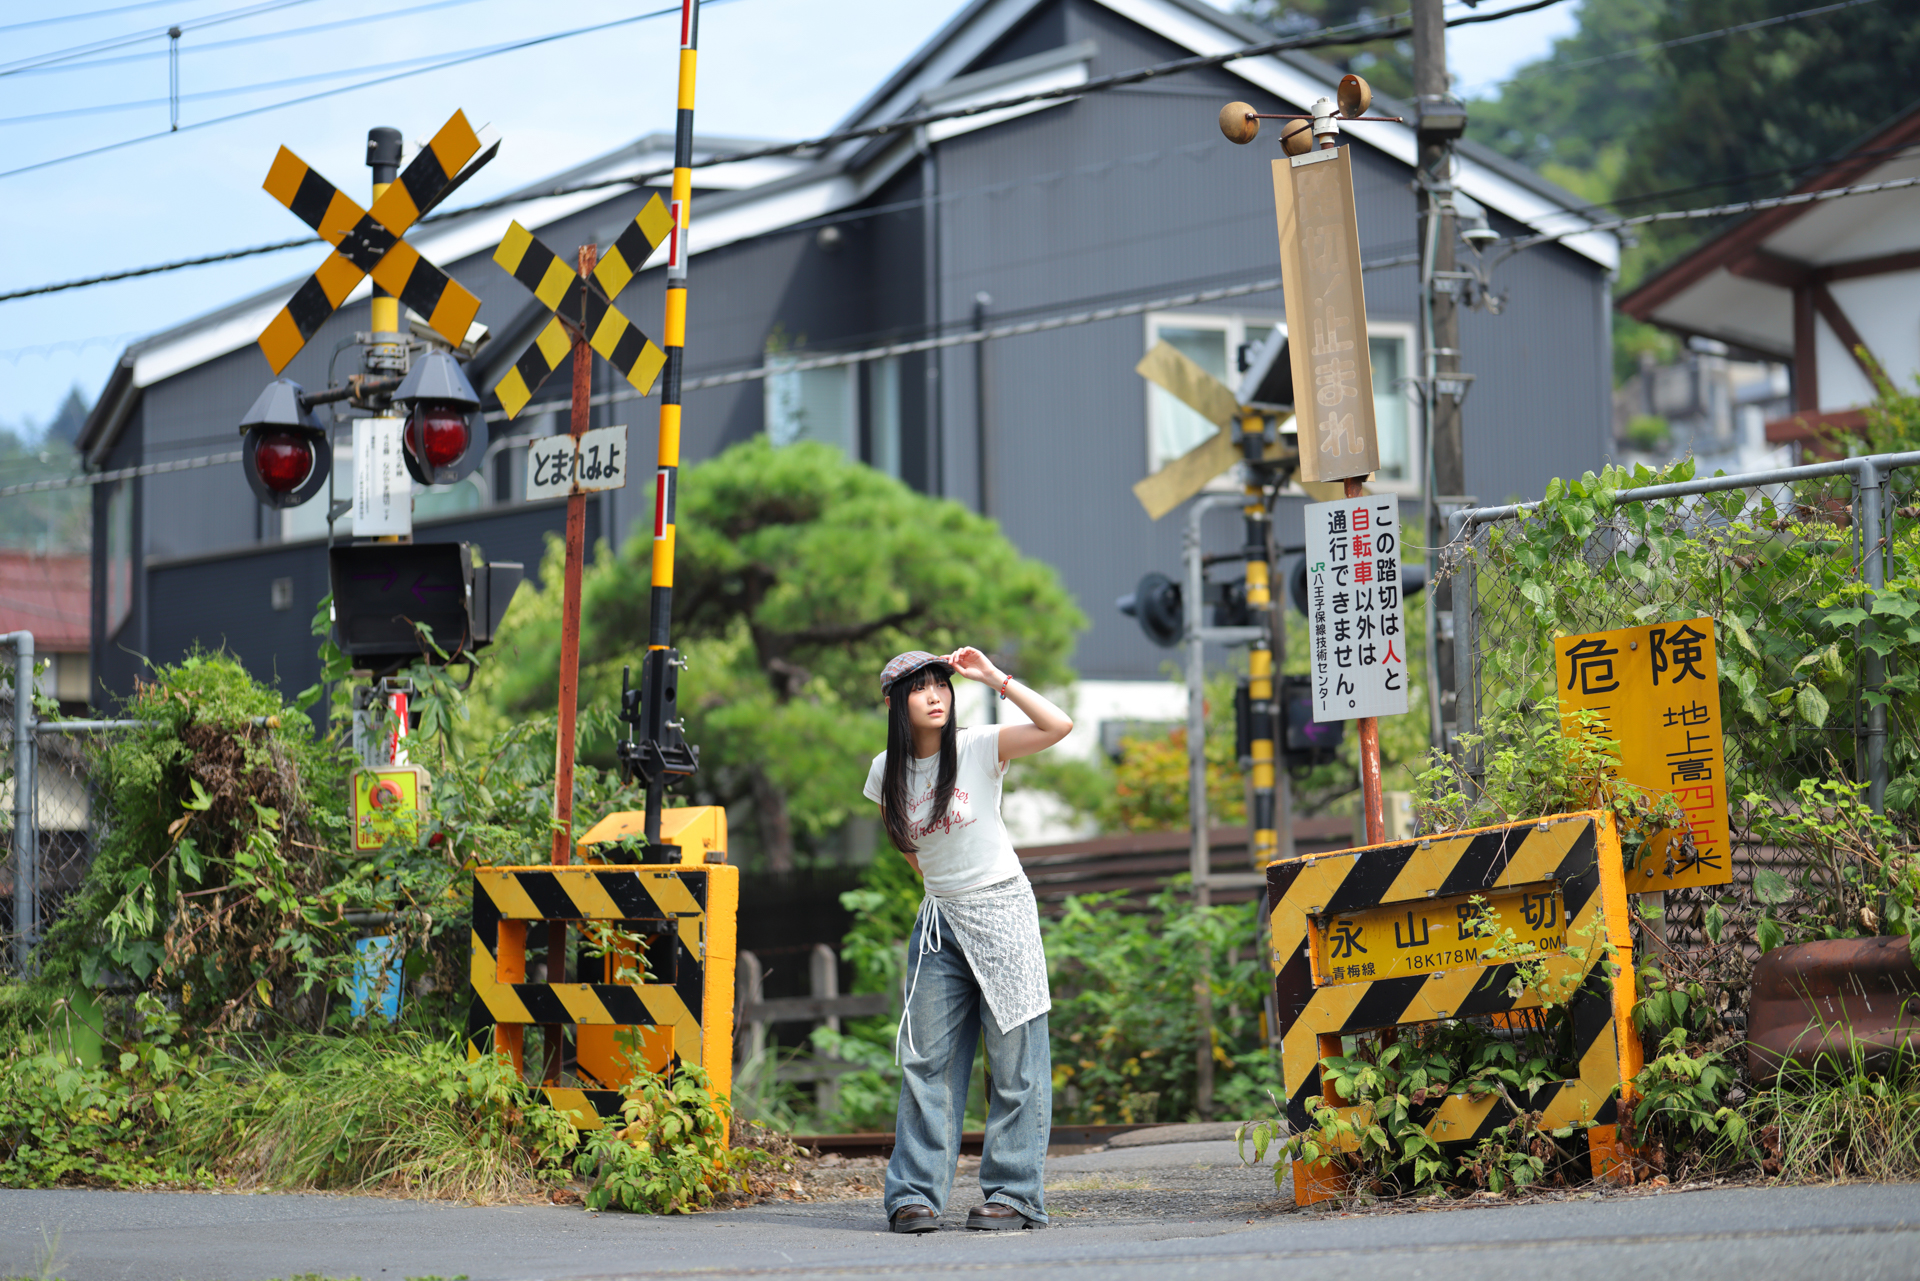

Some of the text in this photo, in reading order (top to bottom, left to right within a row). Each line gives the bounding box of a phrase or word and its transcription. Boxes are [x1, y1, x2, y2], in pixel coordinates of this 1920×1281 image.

[534, 443, 620, 487] とまれみよ
[1327, 509, 1356, 709] 通行できません。
[1352, 507, 1377, 666] 自転車以外は
[1376, 505, 1401, 691] この踏切は人と
[1565, 624, 1707, 695] 危険
[909, 810, 965, 840] Tracy's
[1329, 892, 1558, 958] 永山踏切
[1332, 962, 1377, 980] 青梅線
[1405, 947, 1478, 970] 18K178M
